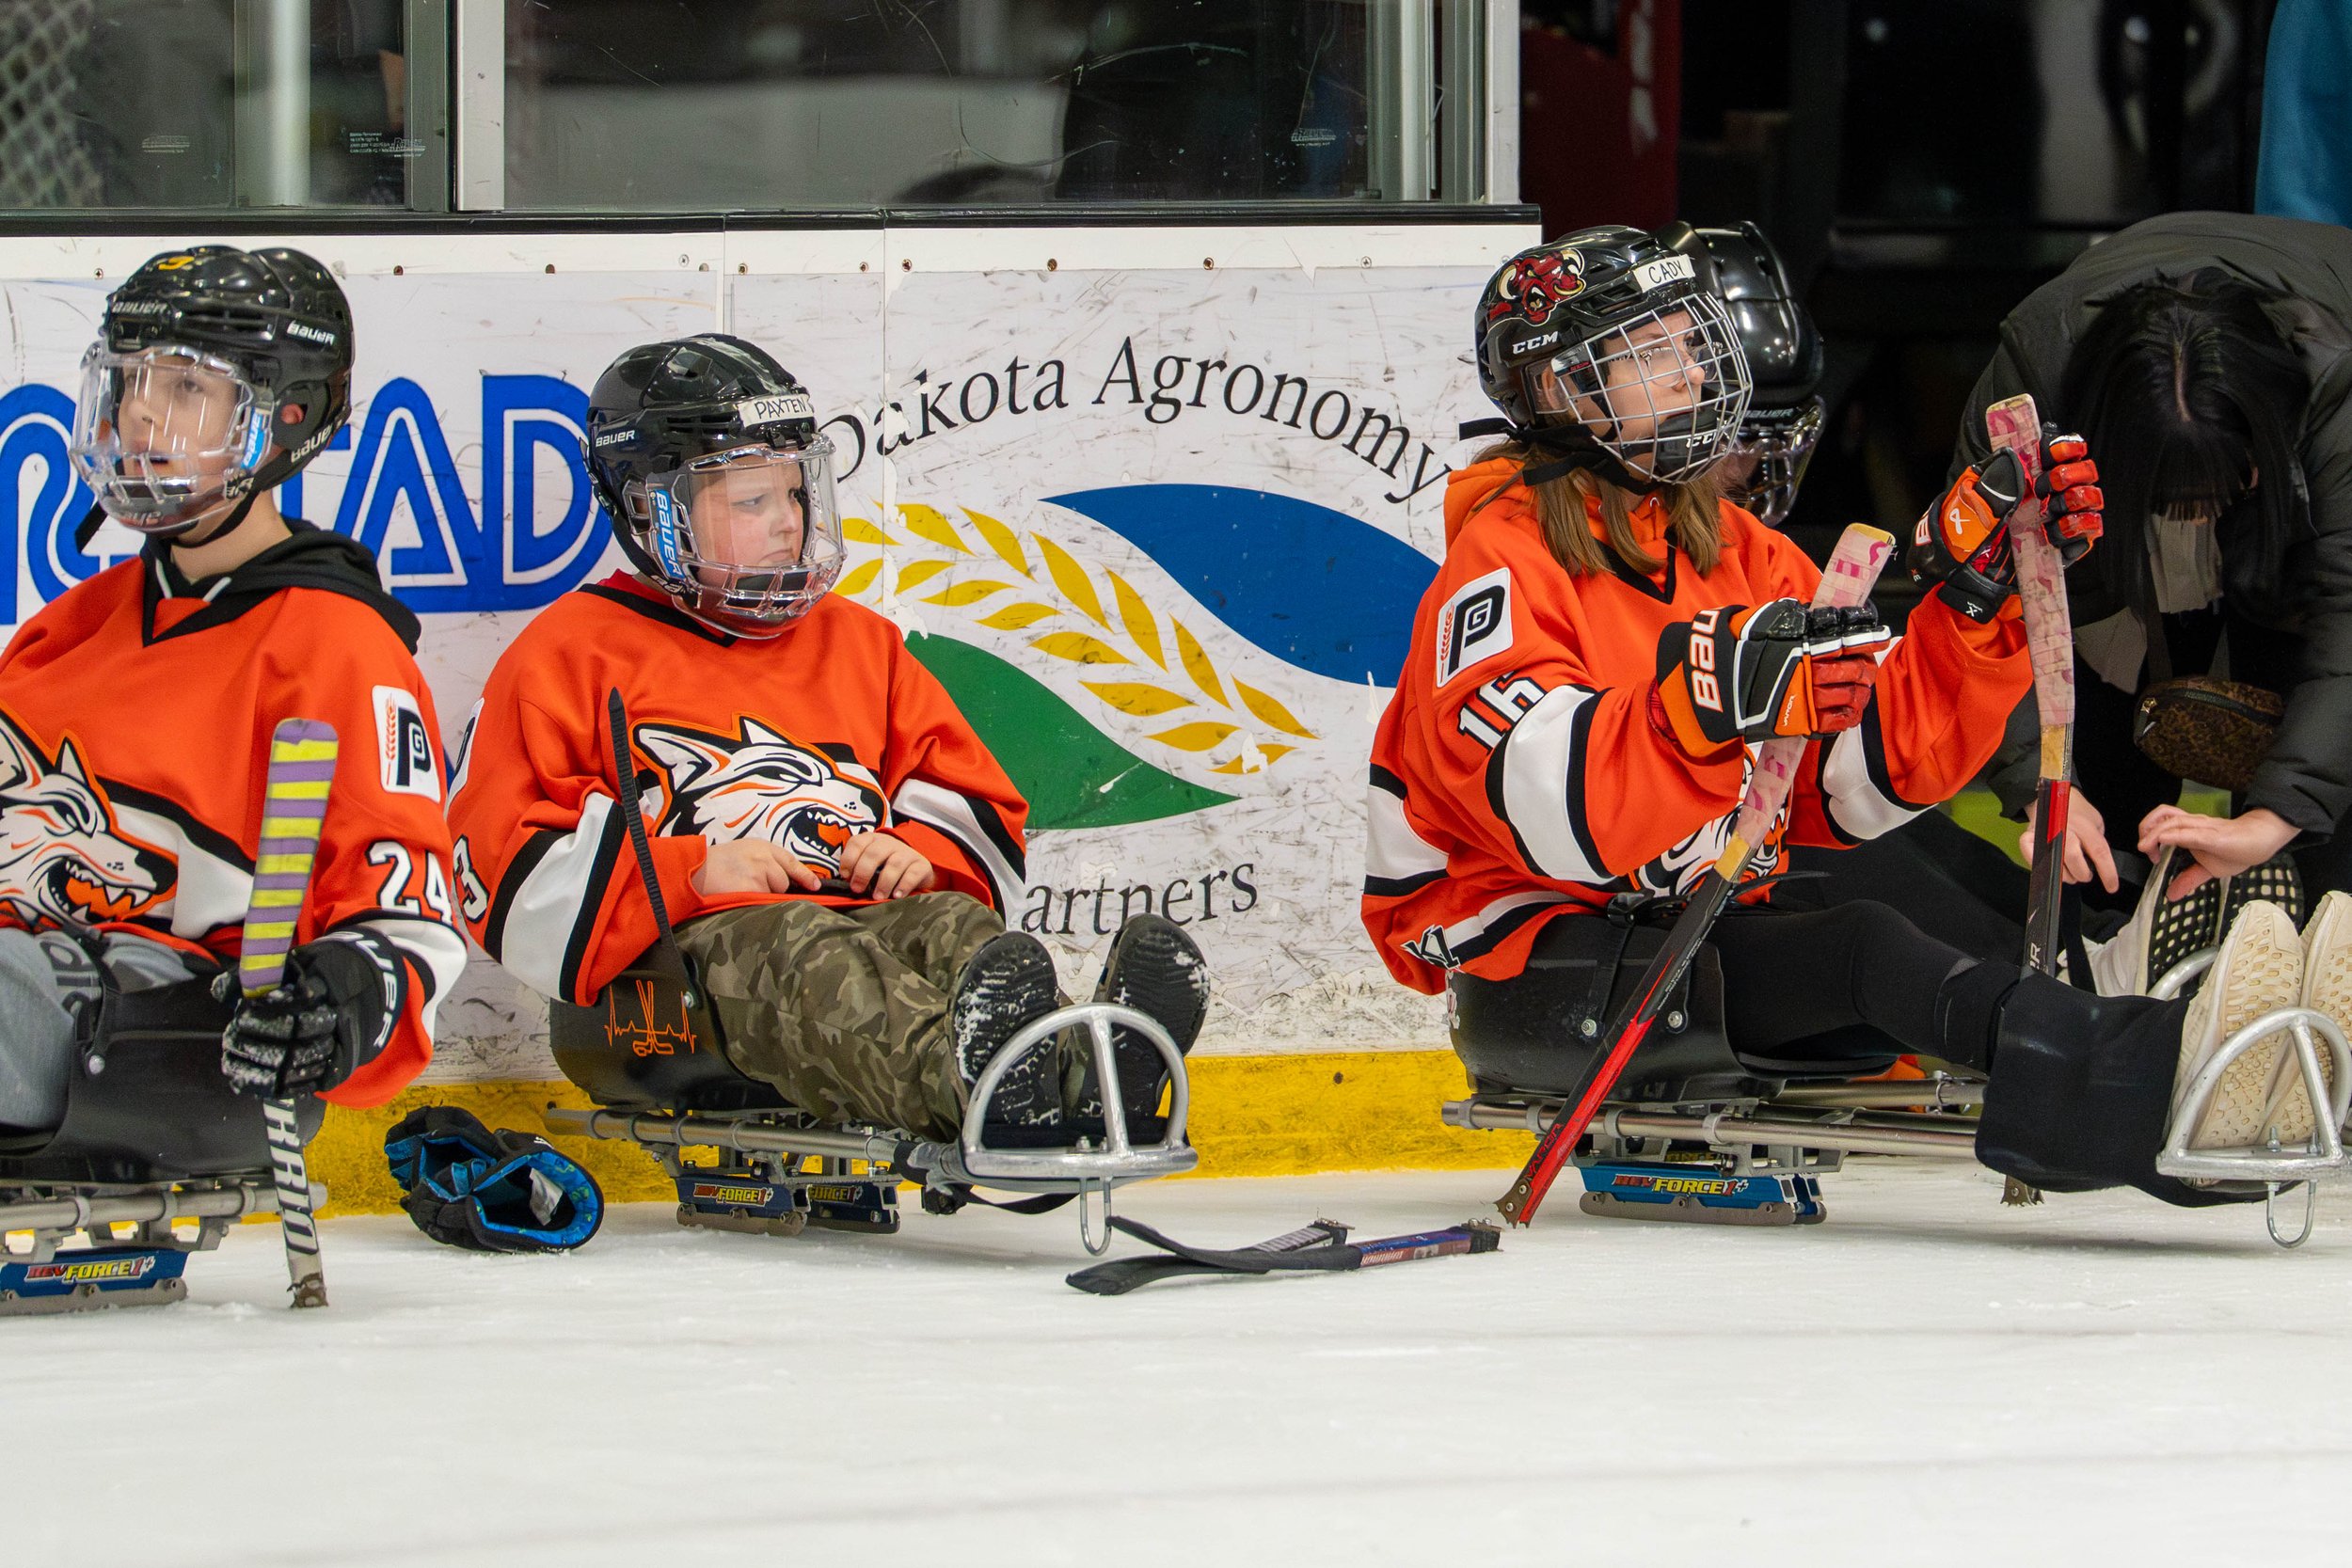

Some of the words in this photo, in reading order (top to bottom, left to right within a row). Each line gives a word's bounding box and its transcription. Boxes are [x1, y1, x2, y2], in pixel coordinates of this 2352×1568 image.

[1648, 260, 1685, 285] CADY
[1512, 330, 1559, 356] CCM
[754, 396, 808, 420] PAXTEN
[1091, 334, 1455, 505] Agronomy
[1457, 670, 1548, 755] 16
[365, 838, 454, 924] 24
[1021, 863, 1260, 936] artners
